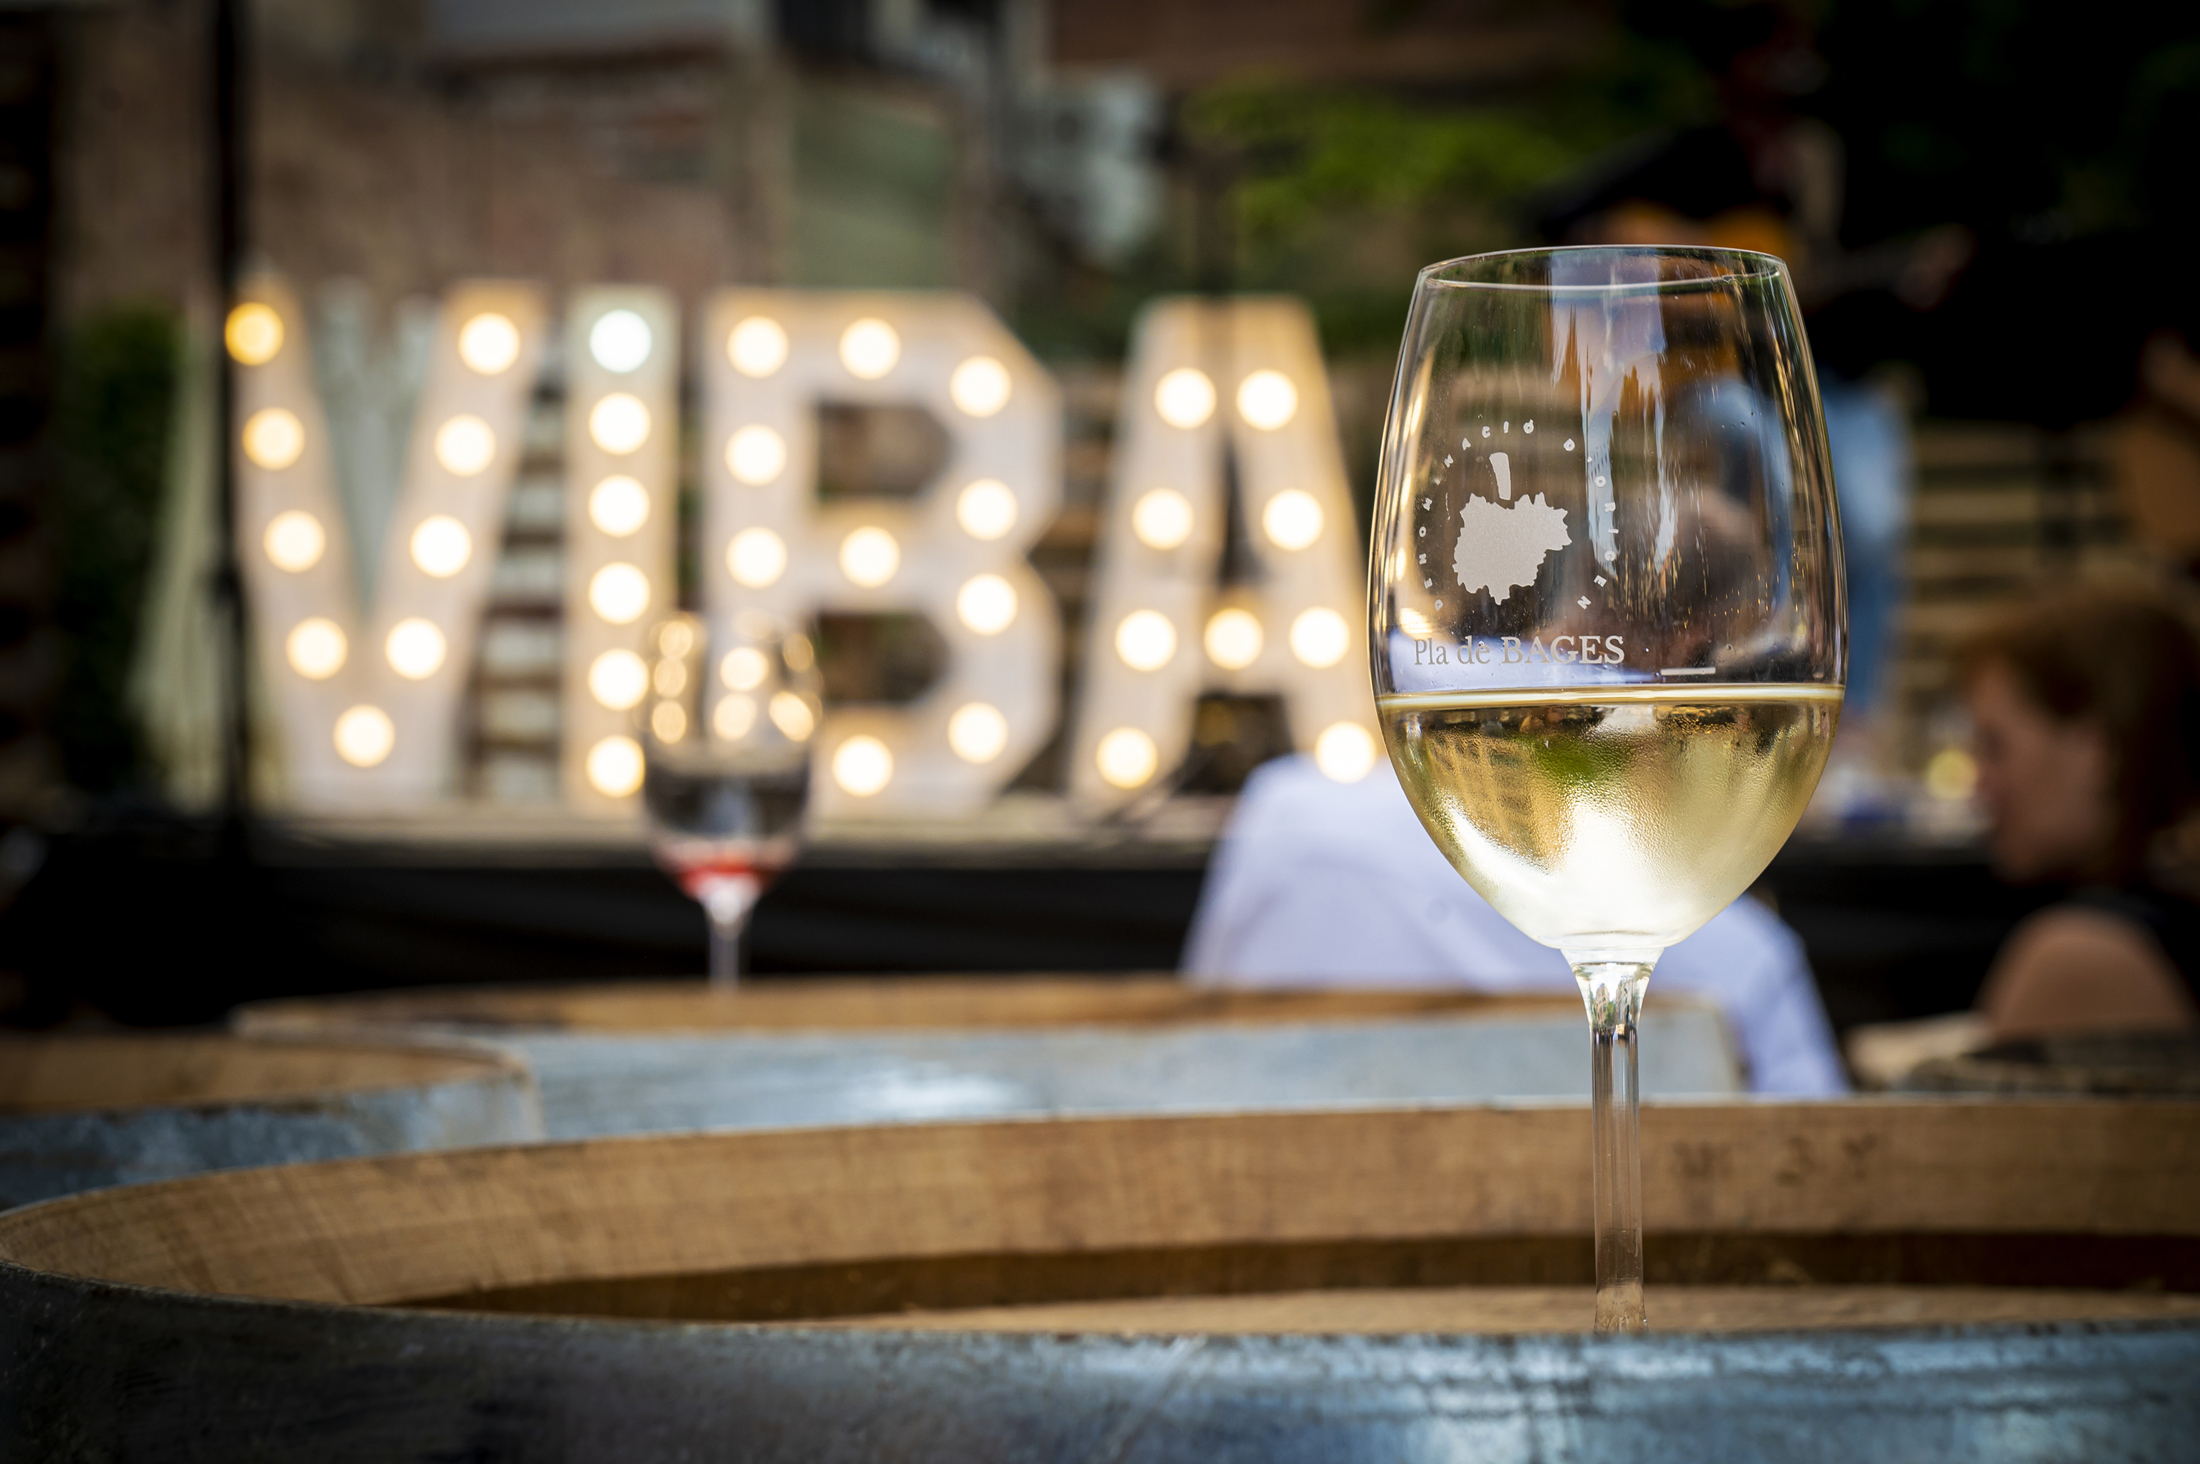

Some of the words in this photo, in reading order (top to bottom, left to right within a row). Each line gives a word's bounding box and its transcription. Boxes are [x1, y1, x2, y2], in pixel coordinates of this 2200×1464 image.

[224, 278, 1382, 822] VIBA
[1414, 637, 1449, 666] Pla
[1456, 635, 1491, 665] de
[1501, 635, 1625, 665] BAGES
